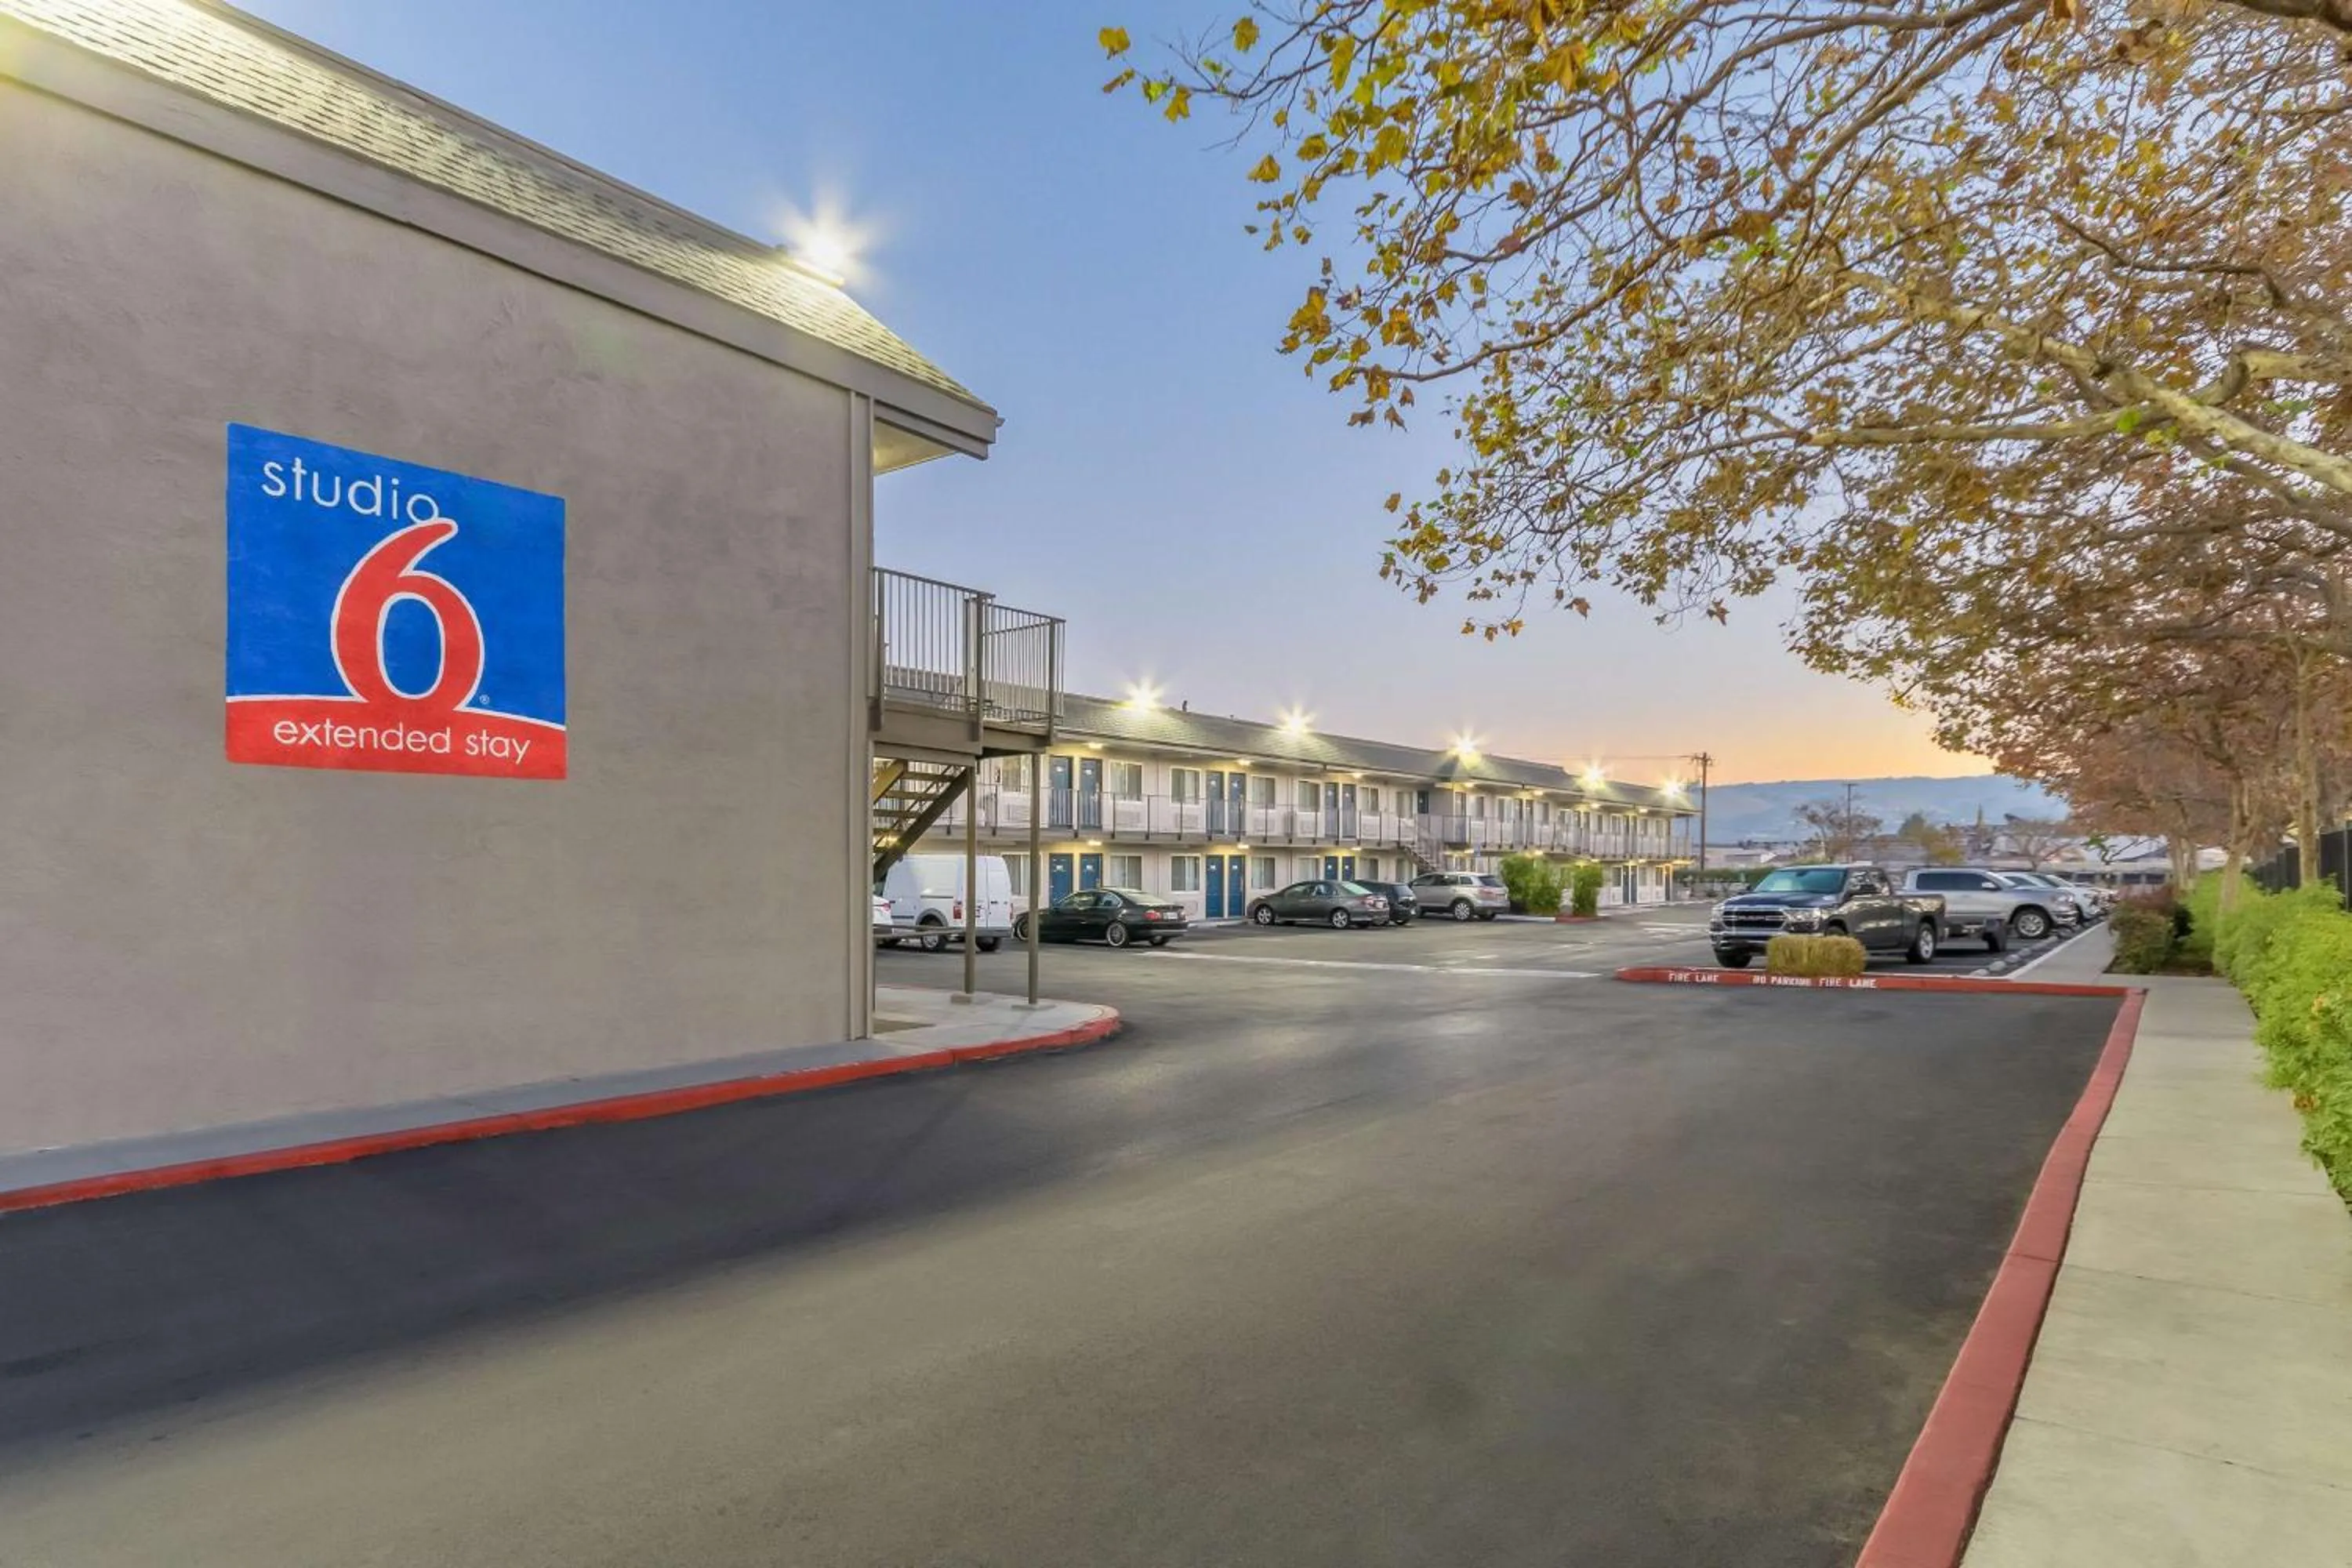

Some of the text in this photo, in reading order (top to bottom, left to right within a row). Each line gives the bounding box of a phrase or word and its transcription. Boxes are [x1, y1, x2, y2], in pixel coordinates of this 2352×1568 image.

[262, 457, 439, 523] studio
[330, 517, 485, 710] 6
[274, 719, 531, 764] extended stay
[1668, 973, 1719, 982] FIRE LANE
[1752, 975, 1877, 989] NO PARKING FIRE LANE
